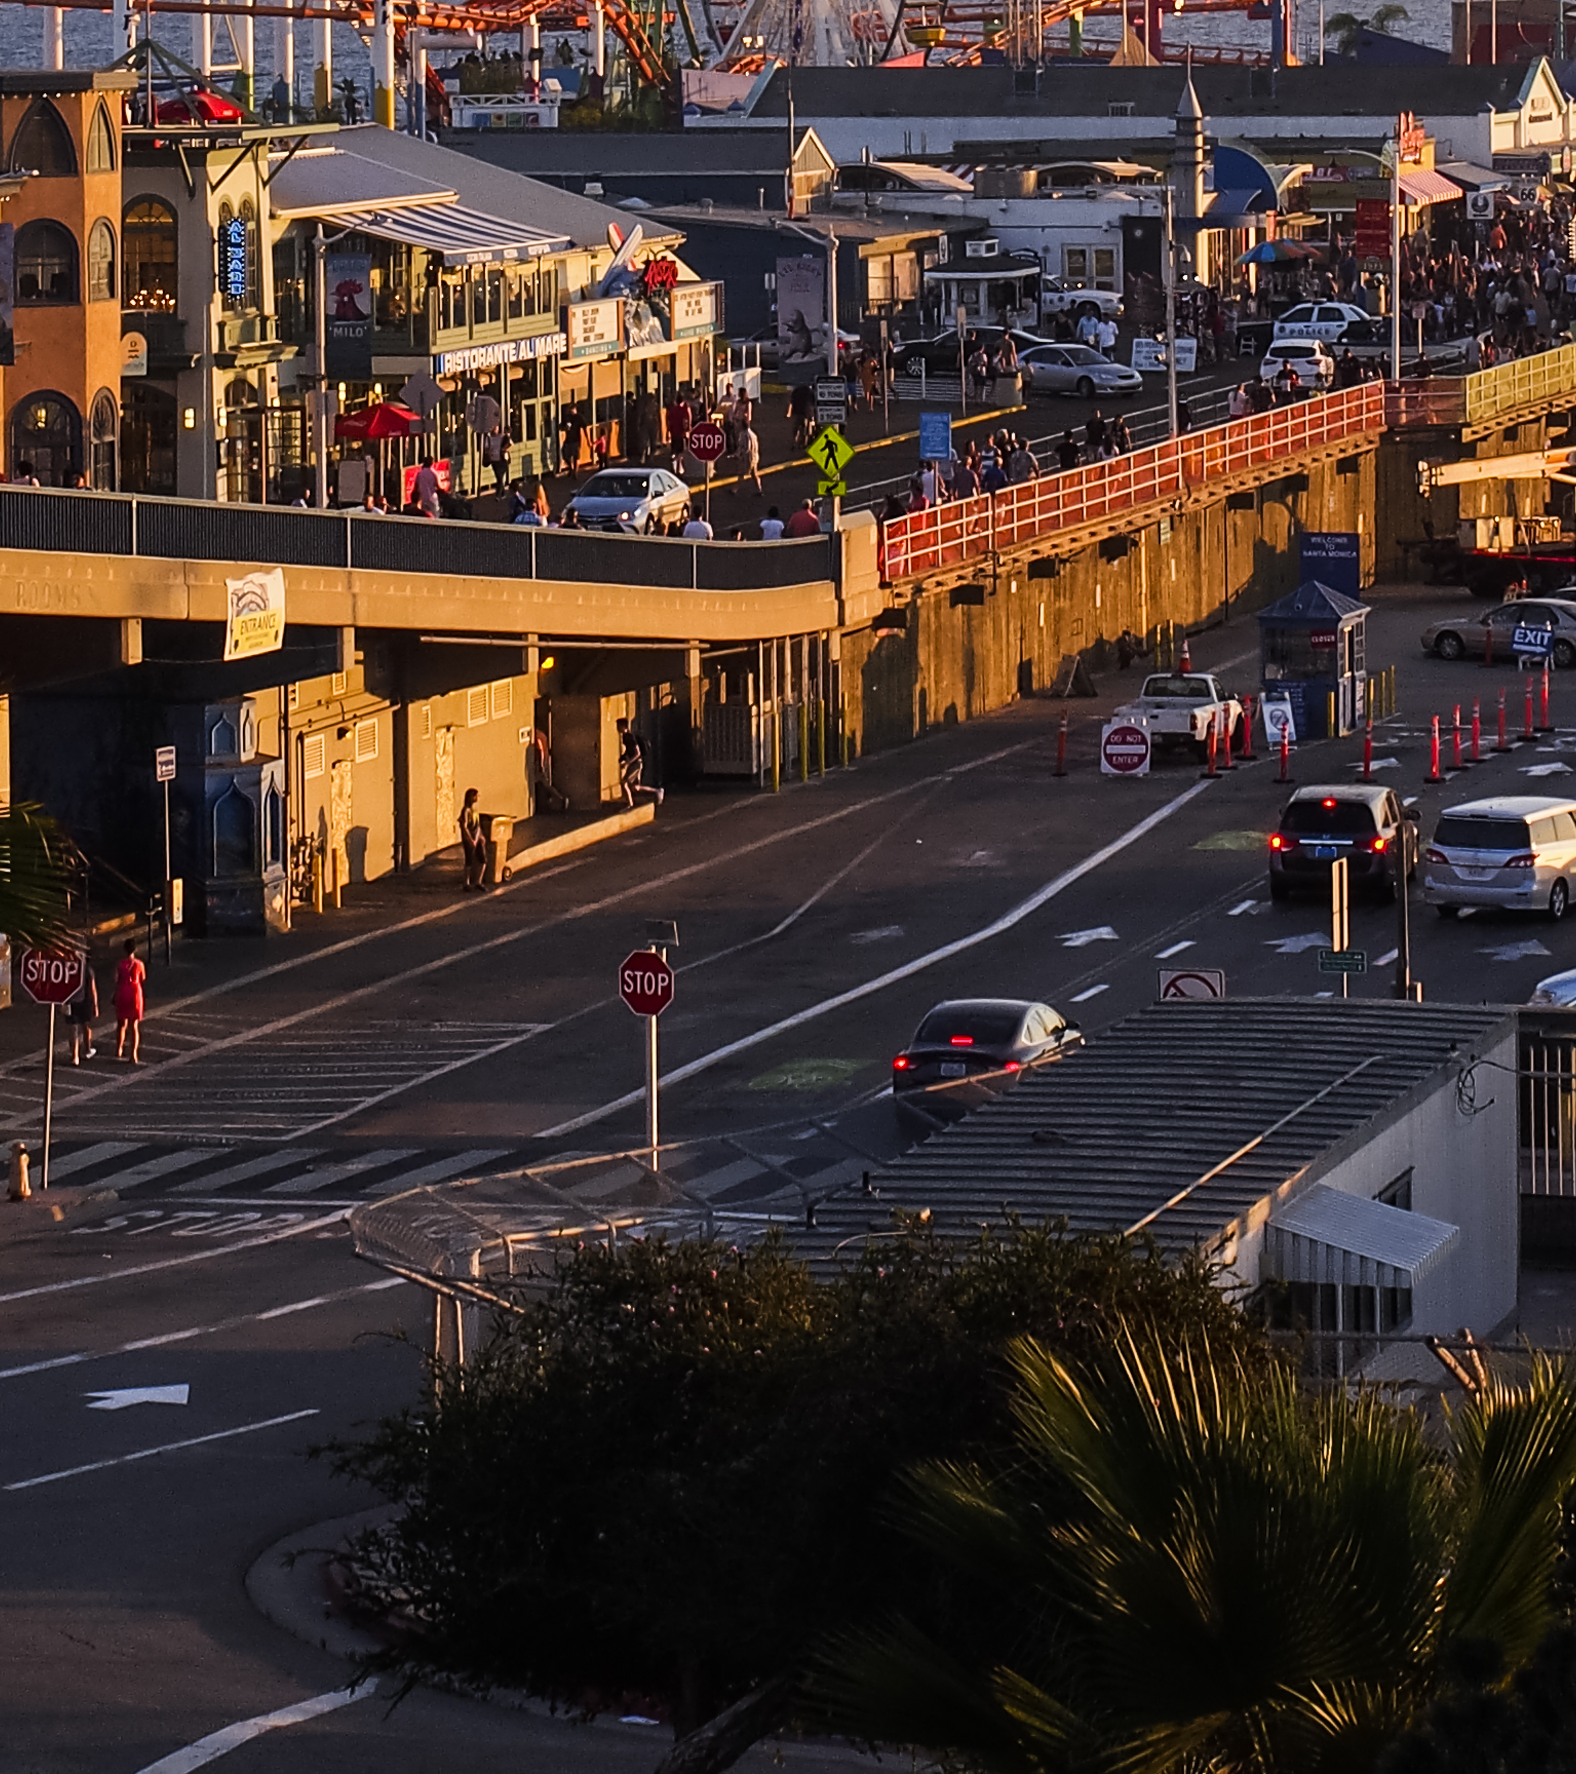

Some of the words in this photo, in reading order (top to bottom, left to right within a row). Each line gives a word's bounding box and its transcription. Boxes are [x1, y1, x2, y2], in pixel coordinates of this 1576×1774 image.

[1289, 327, 1330, 336] POLICE
[443, 342, 517, 374] RISTORANTE
[518, 338, 534, 362] AL
[535, 333, 567, 359] MARE
[691, 433, 723, 450] STOP
[240, 613, 277, 636] ENTRANCE
[1514, 628, 1552, 646] EXIT
[1110, 734, 1123, 743] DO
[1126, 734, 1142, 743] NOT
[1112, 755, 1139, 765] ENTER
[26, 959, 79, 985] STOP
[623, 970, 670, 996] STOP
